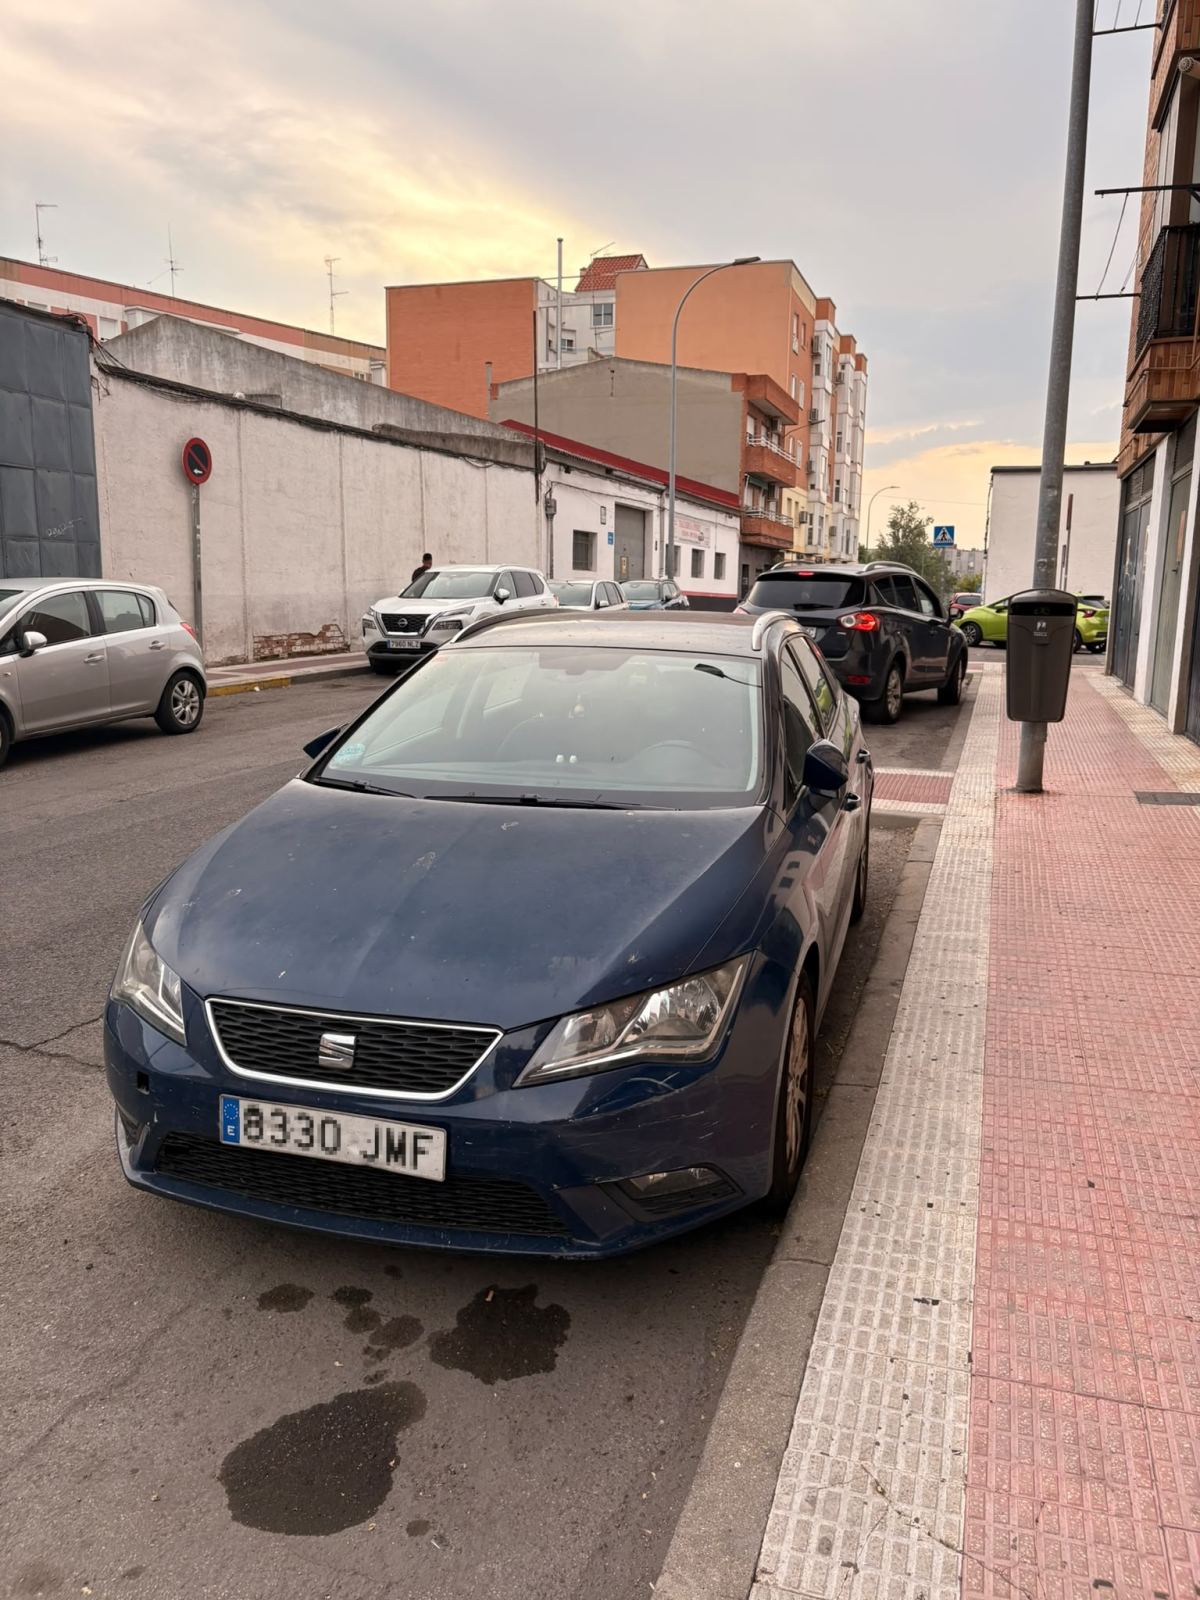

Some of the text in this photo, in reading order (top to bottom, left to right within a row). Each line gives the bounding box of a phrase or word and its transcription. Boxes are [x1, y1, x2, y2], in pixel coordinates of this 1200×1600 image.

[227, 1125, 236, 1137] E
[243, 1104, 434, 1171] 8330 JMF
